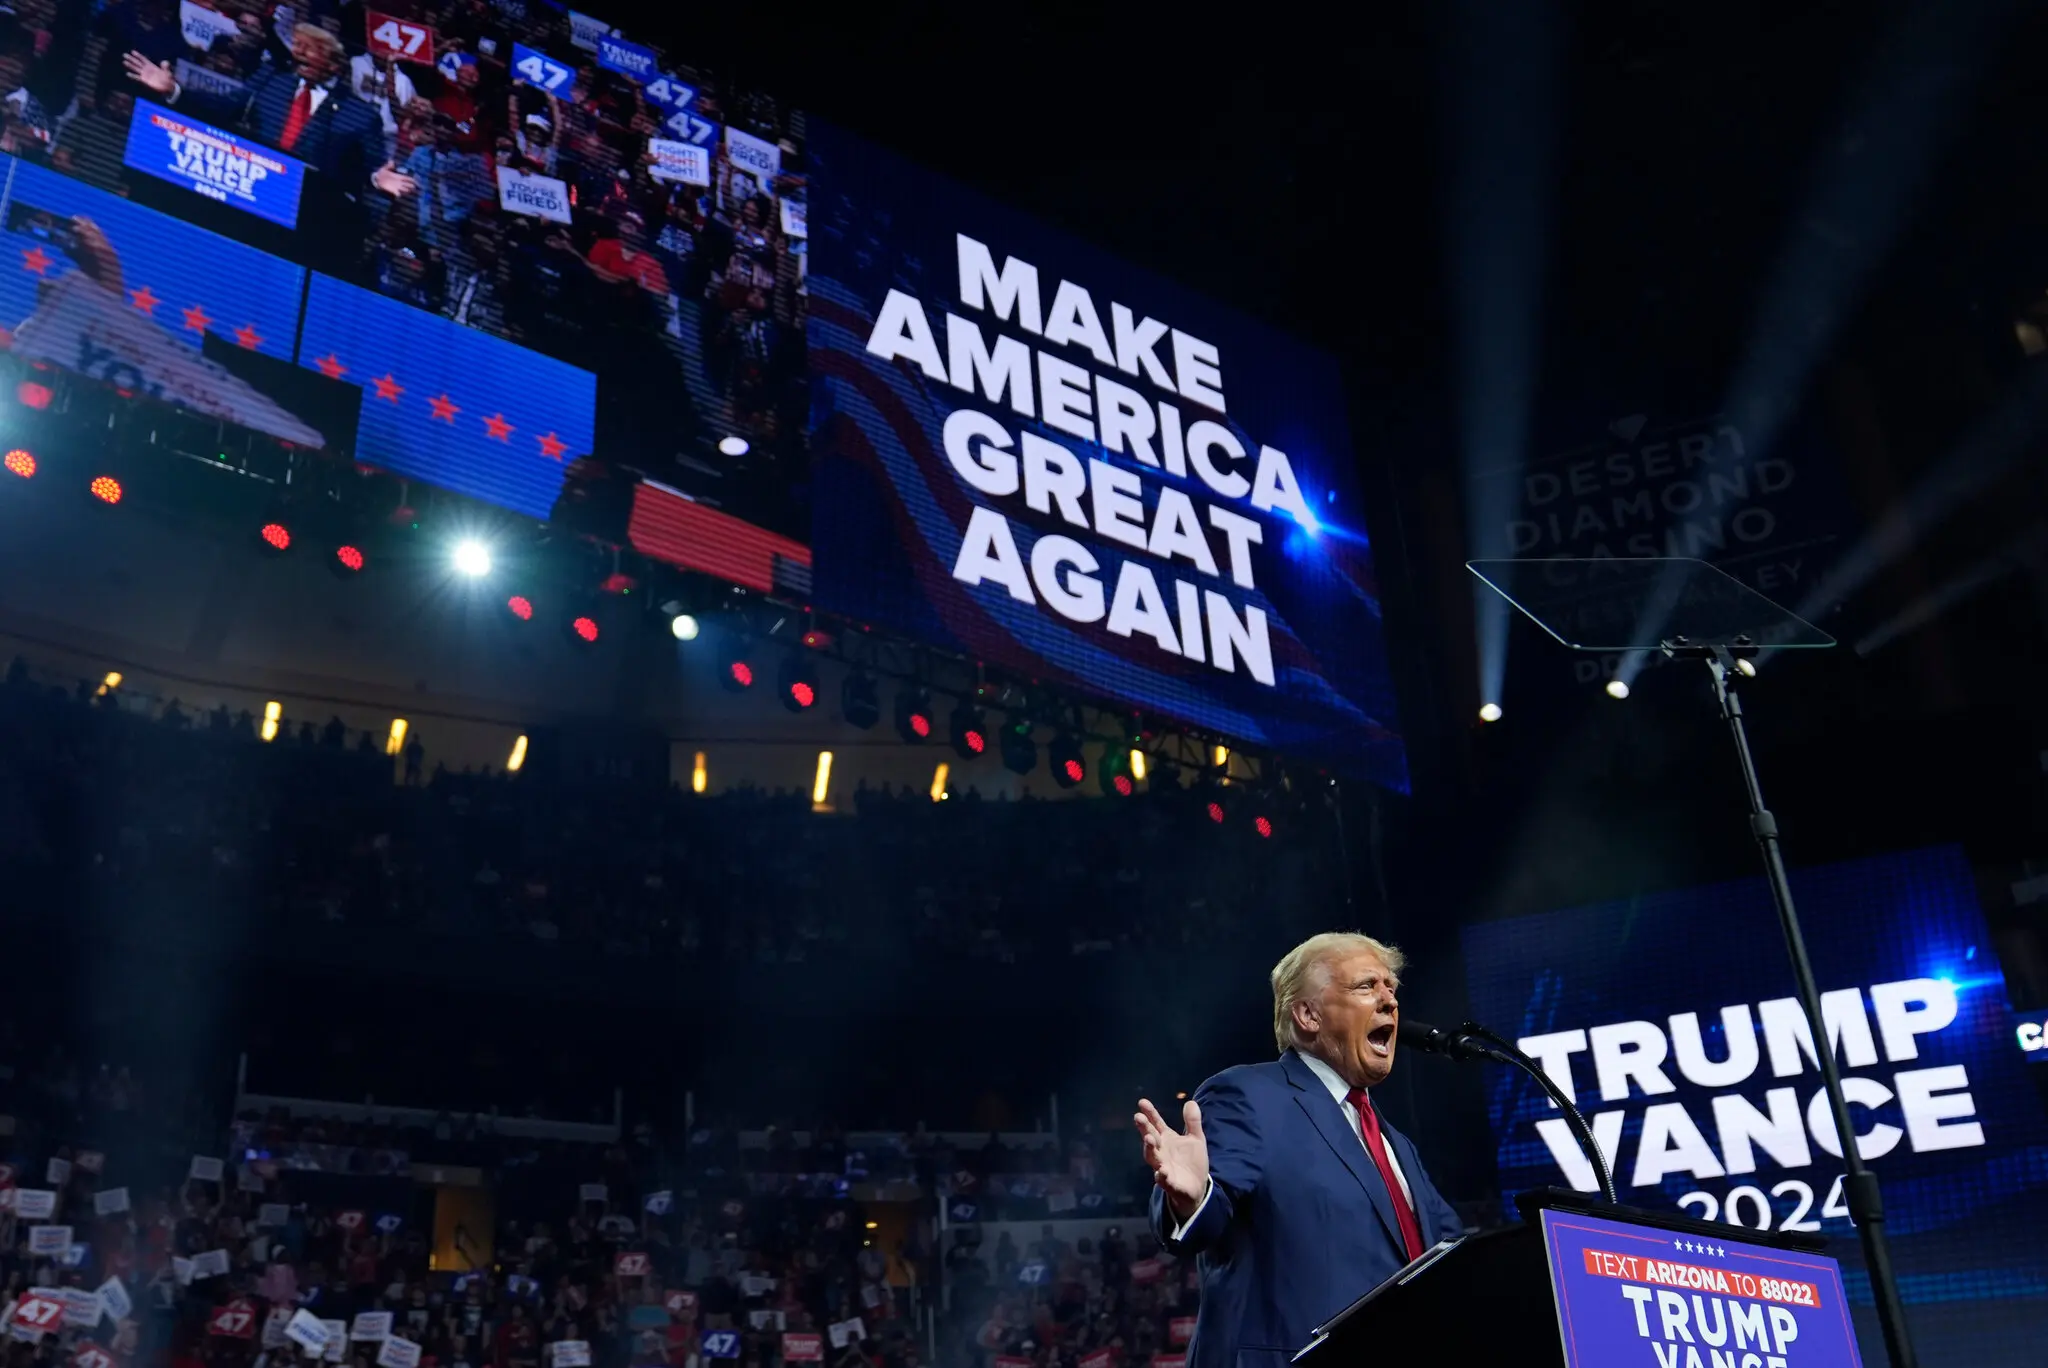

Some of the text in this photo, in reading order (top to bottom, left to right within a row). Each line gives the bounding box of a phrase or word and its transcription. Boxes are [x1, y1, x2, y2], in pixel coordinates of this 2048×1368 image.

[373, 20, 426, 55] 47
[600, 40, 652, 66] TRUMP
[516, 55, 568, 89] 47
[646, 78, 694, 108] 47
[667, 112, 713, 144] 47
[168, 131, 268, 180] TRUMP
[176, 151, 255, 194] VANCE
[506, 189, 564, 212] FIRED!
[509, 180, 557, 199] YOU'RE
[956, 232, 1226, 413] MAKE
[866, 288, 1317, 536] AMERICA
[1526, 425, 1745, 506] DESERT
[942, 408, 1263, 590] GREAT
[1505, 458, 1796, 553] DIAMOND
[1544, 508, 1776, 586] CASINO
[952, 505, 1275, 686] AGAIN
[1518, 977, 1958, 1108] TRUMP
[1534, 1064, 1986, 1192] VANCE
[619, 1255, 646, 1272] 47
[1019, 1265, 1046, 1283] 47
[1591, 1251, 1814, 1306] TEXT ARIZONA TO 88022
[17, 1299, 60, 1324] 47
[215, 1312, 251, 1331] 47
[668, 1294, 694, 1310] 47
[1622, 1284, 1798, 1355] TRUMP
[703, 1333, 735, 1353] 47
